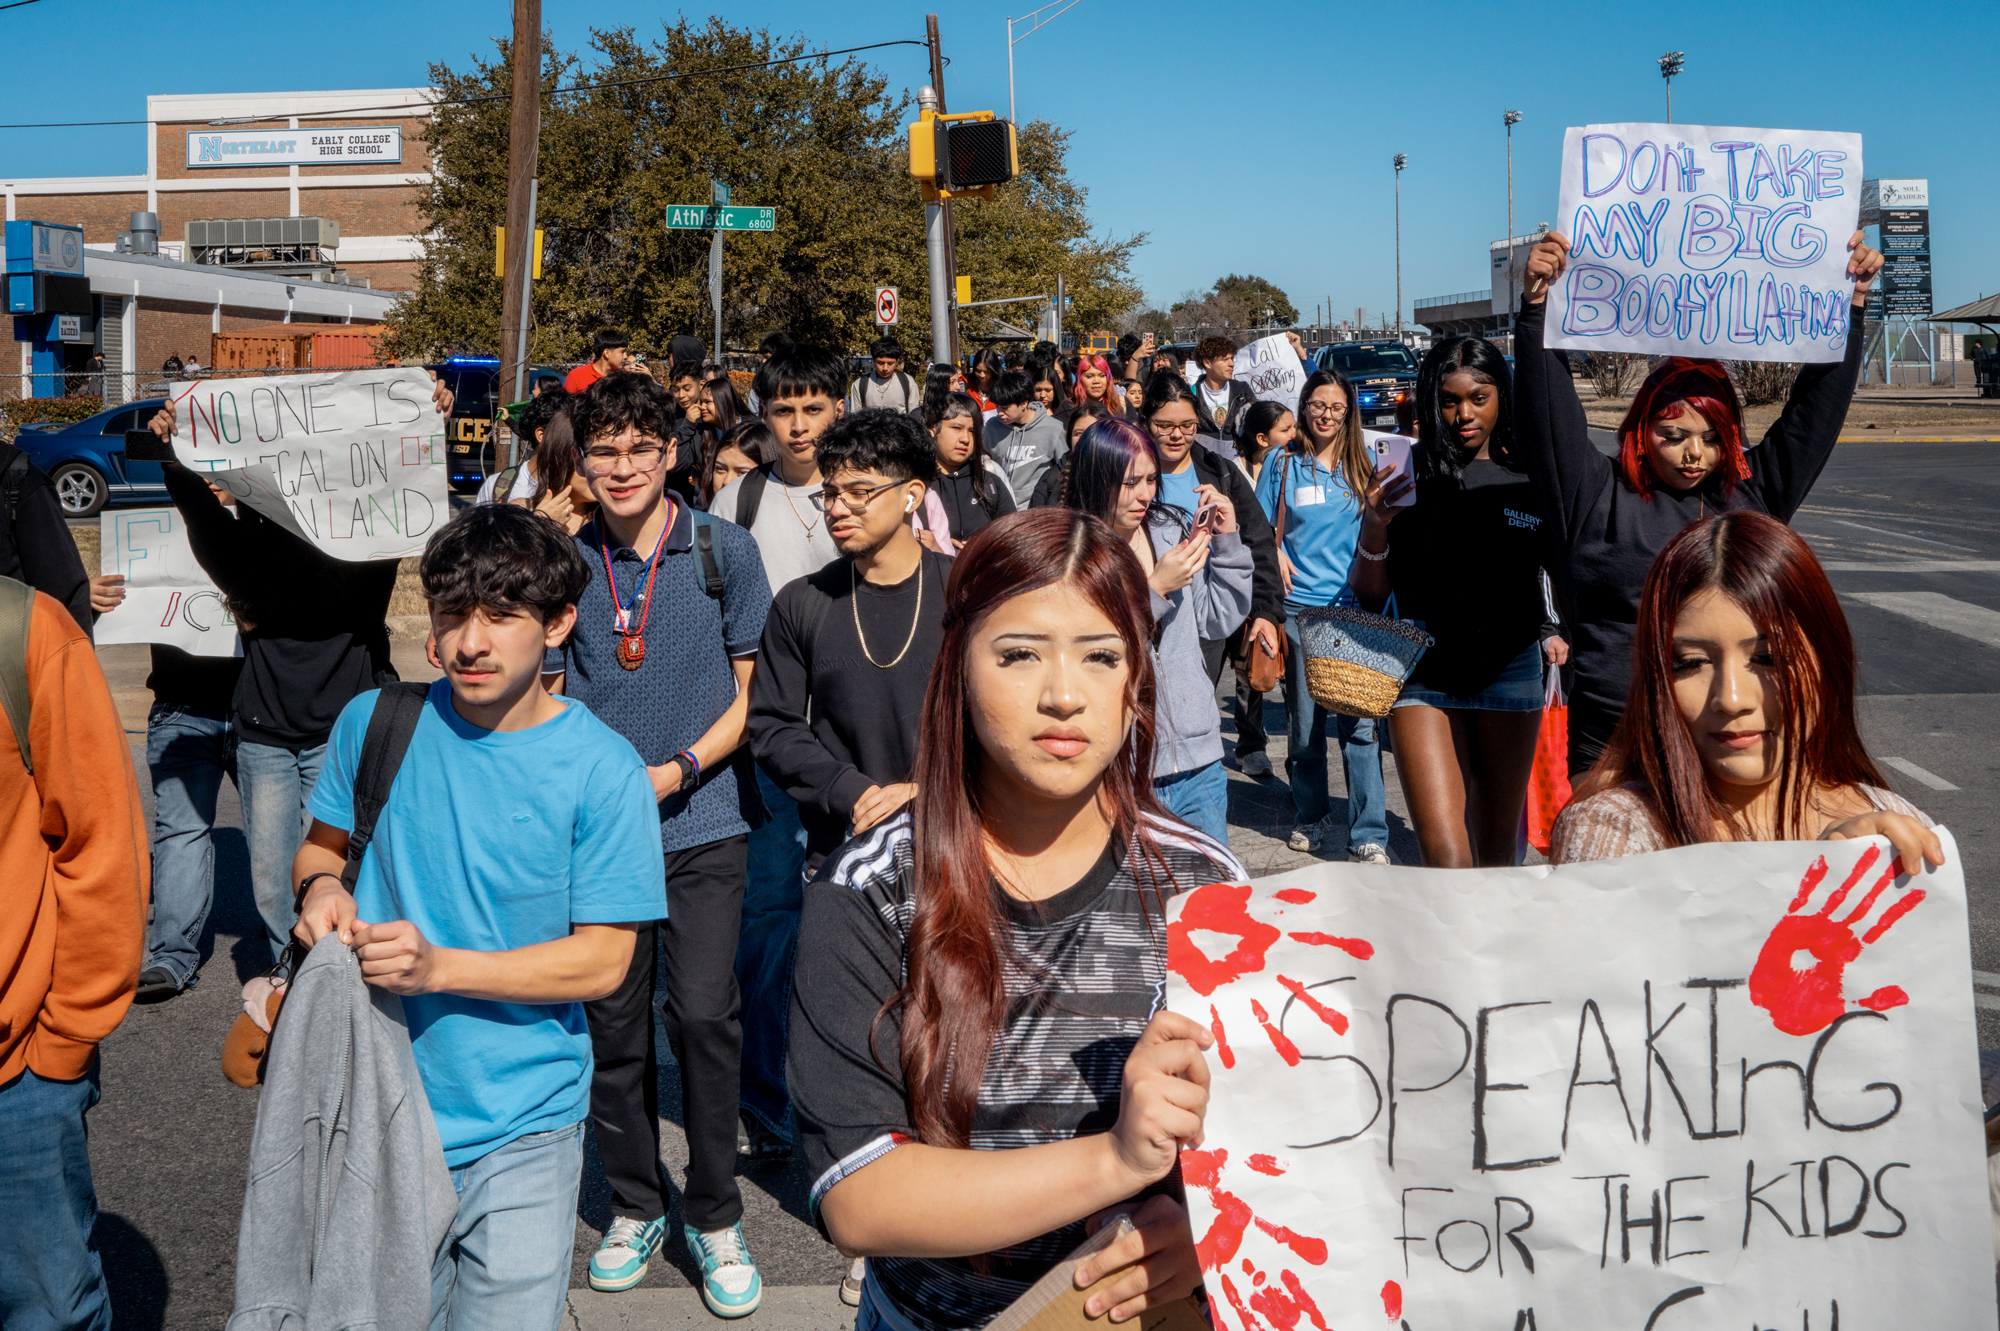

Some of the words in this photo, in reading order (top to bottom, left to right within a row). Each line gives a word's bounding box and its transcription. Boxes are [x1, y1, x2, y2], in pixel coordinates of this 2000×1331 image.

[199, 136, 297, 162] NORTHEAST
[311, 136, 344, 145] EARLY
[349, 135, 391, 144] COLLEGE
[319, 146, 343, 155] HIGH
[347, 145, 383, 154] SCHOOL
[1710, 141, 1848, 202] TAKE
[672, 208, 734, 227] Athletic
[760, 209, 772, 218] DR
[748, 220, 772, 229] 6800
[1569, 197, 1670, 268] MY
[1679, 193, 1828, 271] BIG
[189, 390, 242, 448] NO
[251, 382, 343, 443] ONE
[360, 379, 421, 428] IS
[448, 417, 491, 443] ICE
[350, 439, 388, 488] ON
[329, 489, 434, 539] LAND
[1508, 517, 1537, 531] DEPT.
[1571, 1174, 1711, 1270] THE
[1742, 1154, 1912, 1250] KIDS
